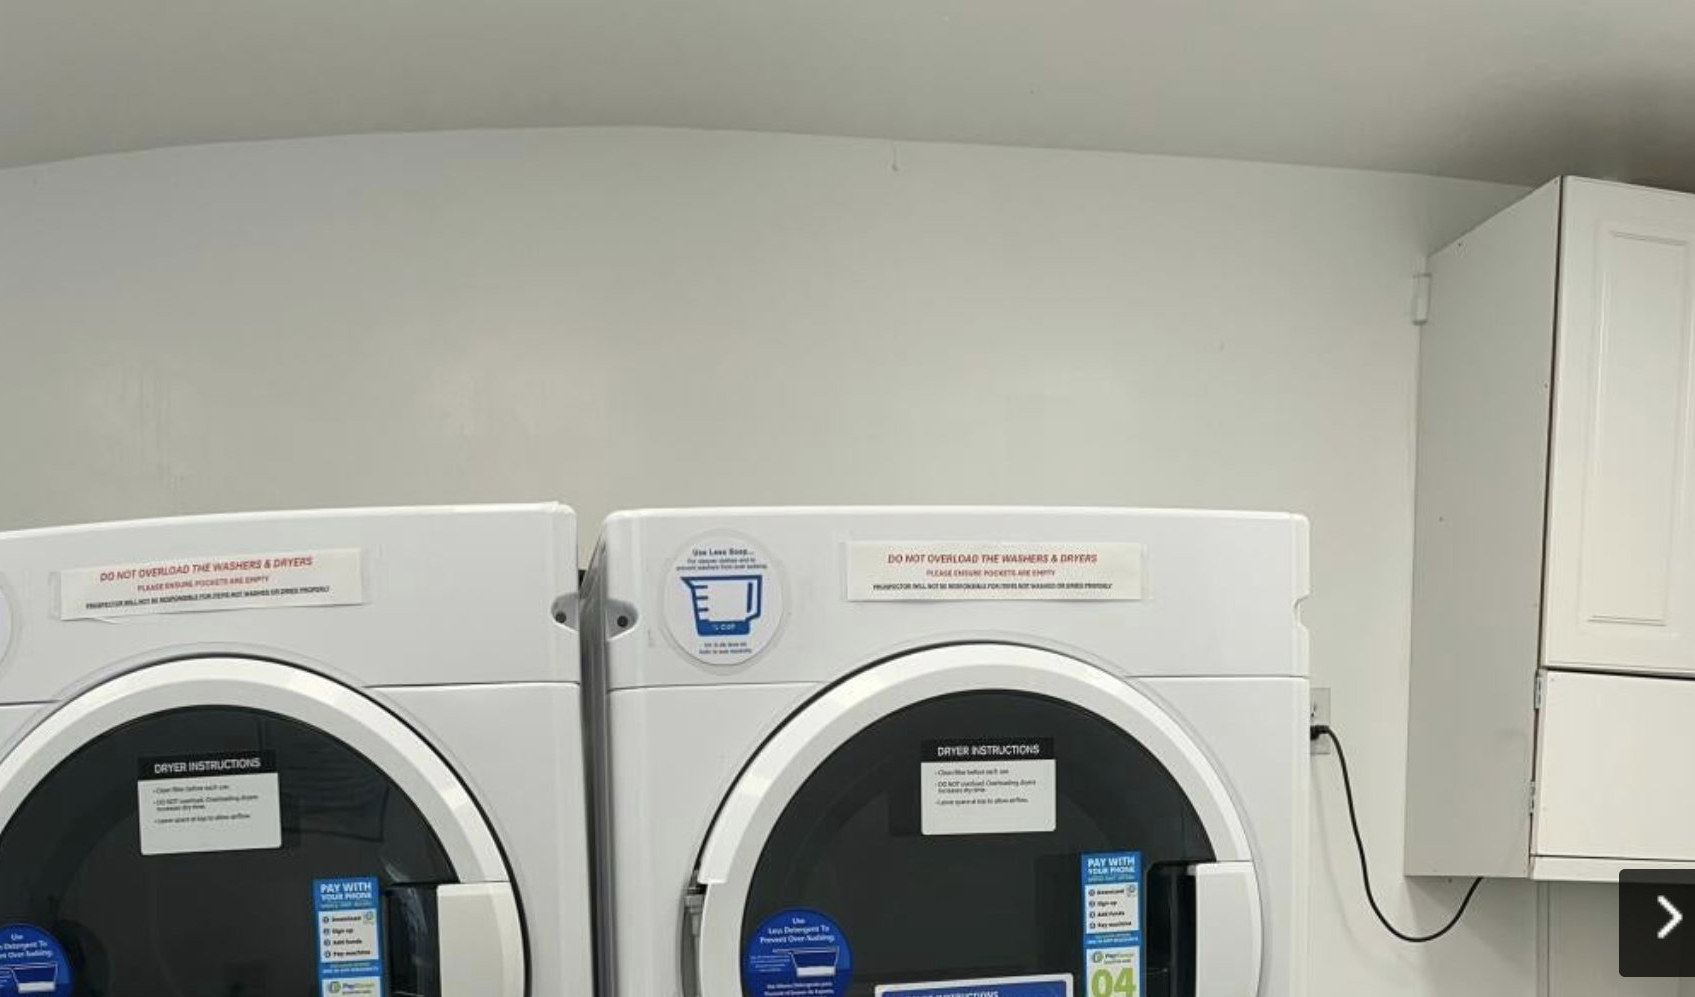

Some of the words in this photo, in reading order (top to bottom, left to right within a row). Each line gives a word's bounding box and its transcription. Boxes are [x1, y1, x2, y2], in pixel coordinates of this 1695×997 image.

[692, 549, 707, 557] Use
[709, 548, 727, 556] Less
[888, 554, 903, 564] DO
[905, 554, 926, 564] NOT
[927, 553, 979, 564] OVERLOAD
[981, 553, 999, 563] THE
[1001, 553, 1049, 564] WASHERS
[1050, 554, 1059, 563] &
[1060, 553, 1098, 563] DRYERS
[100, 572, 114, 582] DO
[116, 570, 137, 580] NOT
[138, 564, 190, 578] OVERLOAD
[192, 562, 211, 573] THE
[213, 559, 262, 572] WASHERS
[264, 560, 271, 569] &
[273, 556, 313, 568] DRYERS
[925, 569, 952, 577] PLEASE
[953, 569, 981, 577] ENSURE
[983, 569, 1016, 577] POCKETS
[1018, 569, 1031, 577] ARE
[1032, 569, 1056, 577] EMPTY
[937, 746, 970, 757] DRYER
[971, 744, 1040, 756] INSTRUCTIONS
[154, 762, 187, 774] DRYER
[188, 757, 261, 772] INSTRUCTIONS
[1087, 858, 1106, 868] PAY
[1108, 856, 1135, 866] WITH
[1087, 867, 1109, 875] YOUR
[1110, 866, 1136, 874] PHONE
[320, 883, 341, 893] PAY
[342, 881, 371, 892] WITH
[792, 917, 806, 925] Use
